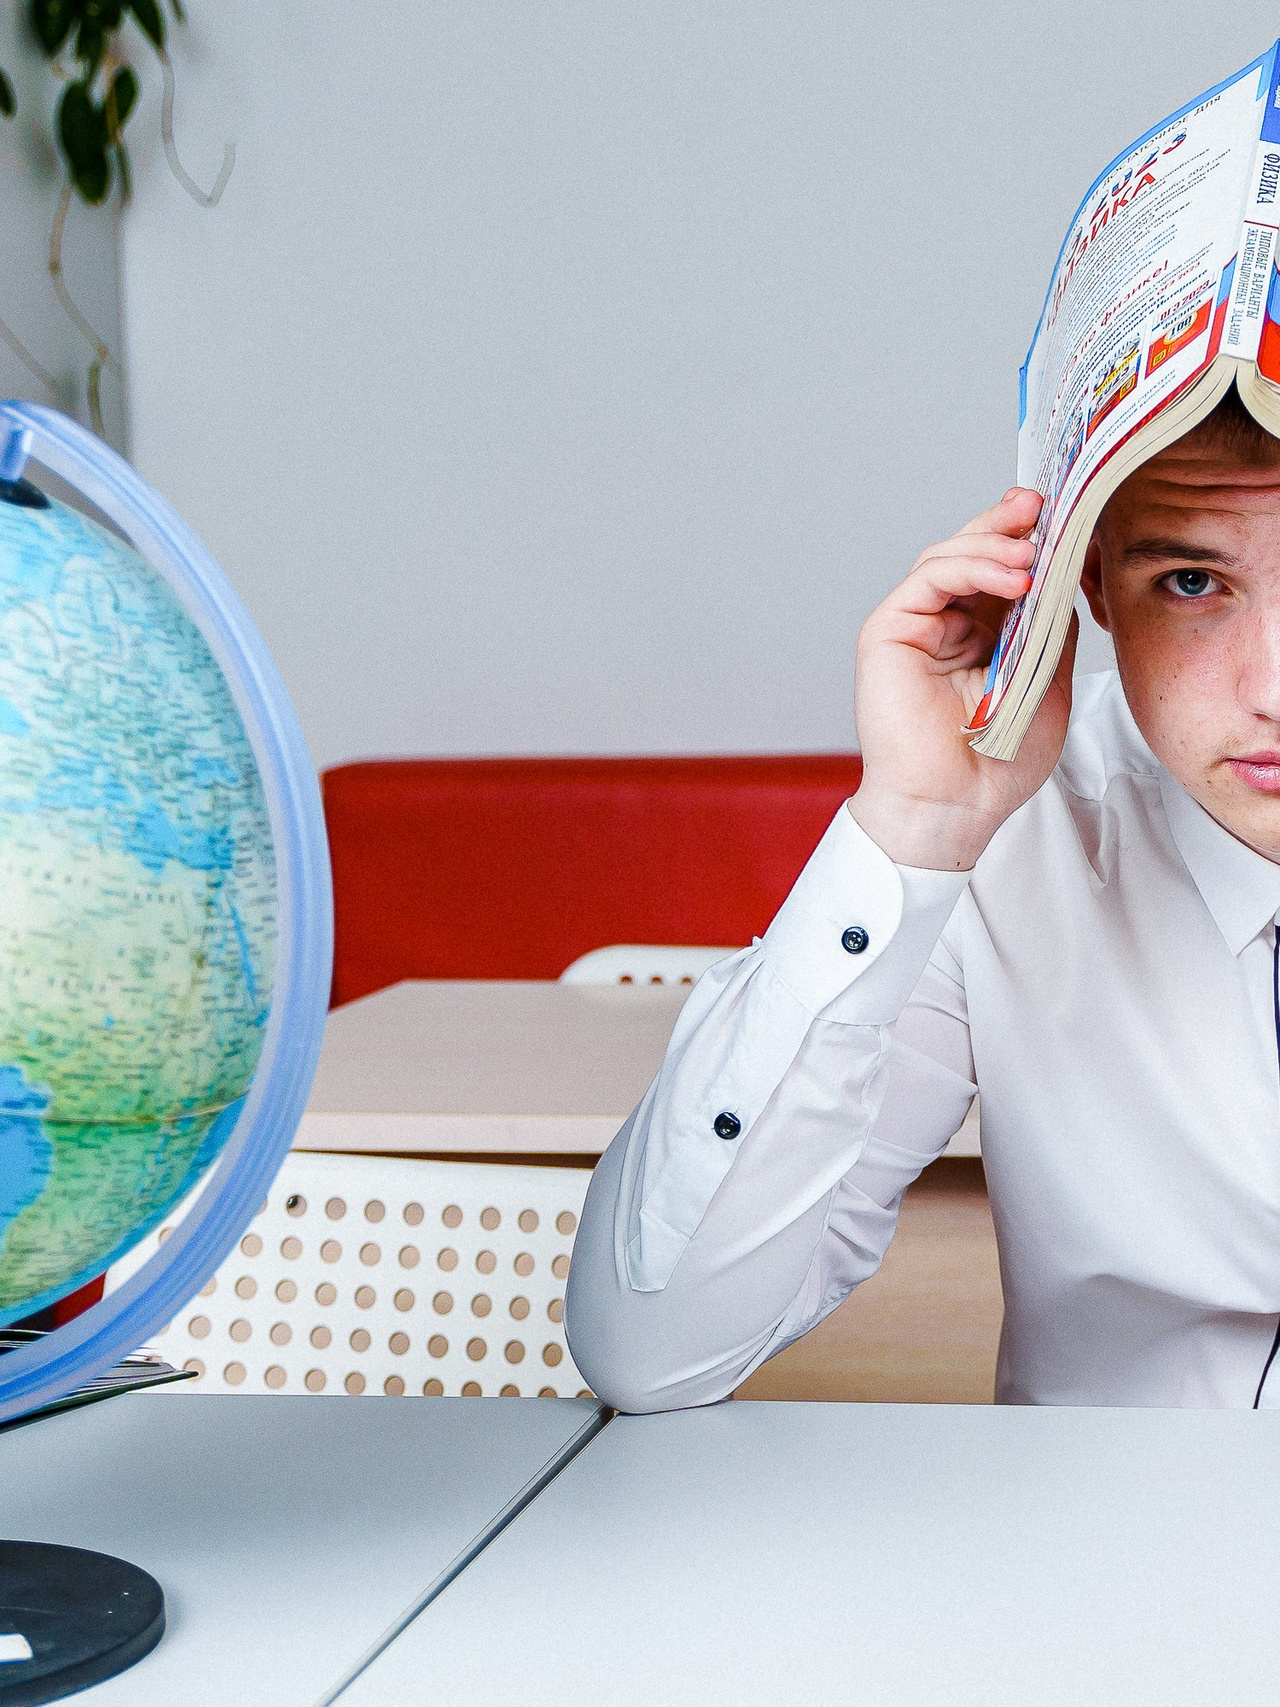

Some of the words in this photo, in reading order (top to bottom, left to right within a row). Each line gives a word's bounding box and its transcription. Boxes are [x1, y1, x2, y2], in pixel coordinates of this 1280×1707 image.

[1256, 230, 1273, 271] ТИПОВЫЕ
[1101, 260, 1168, 327] физике!
[1247, 272, 1265, 320] ВАРИАНТЫ
